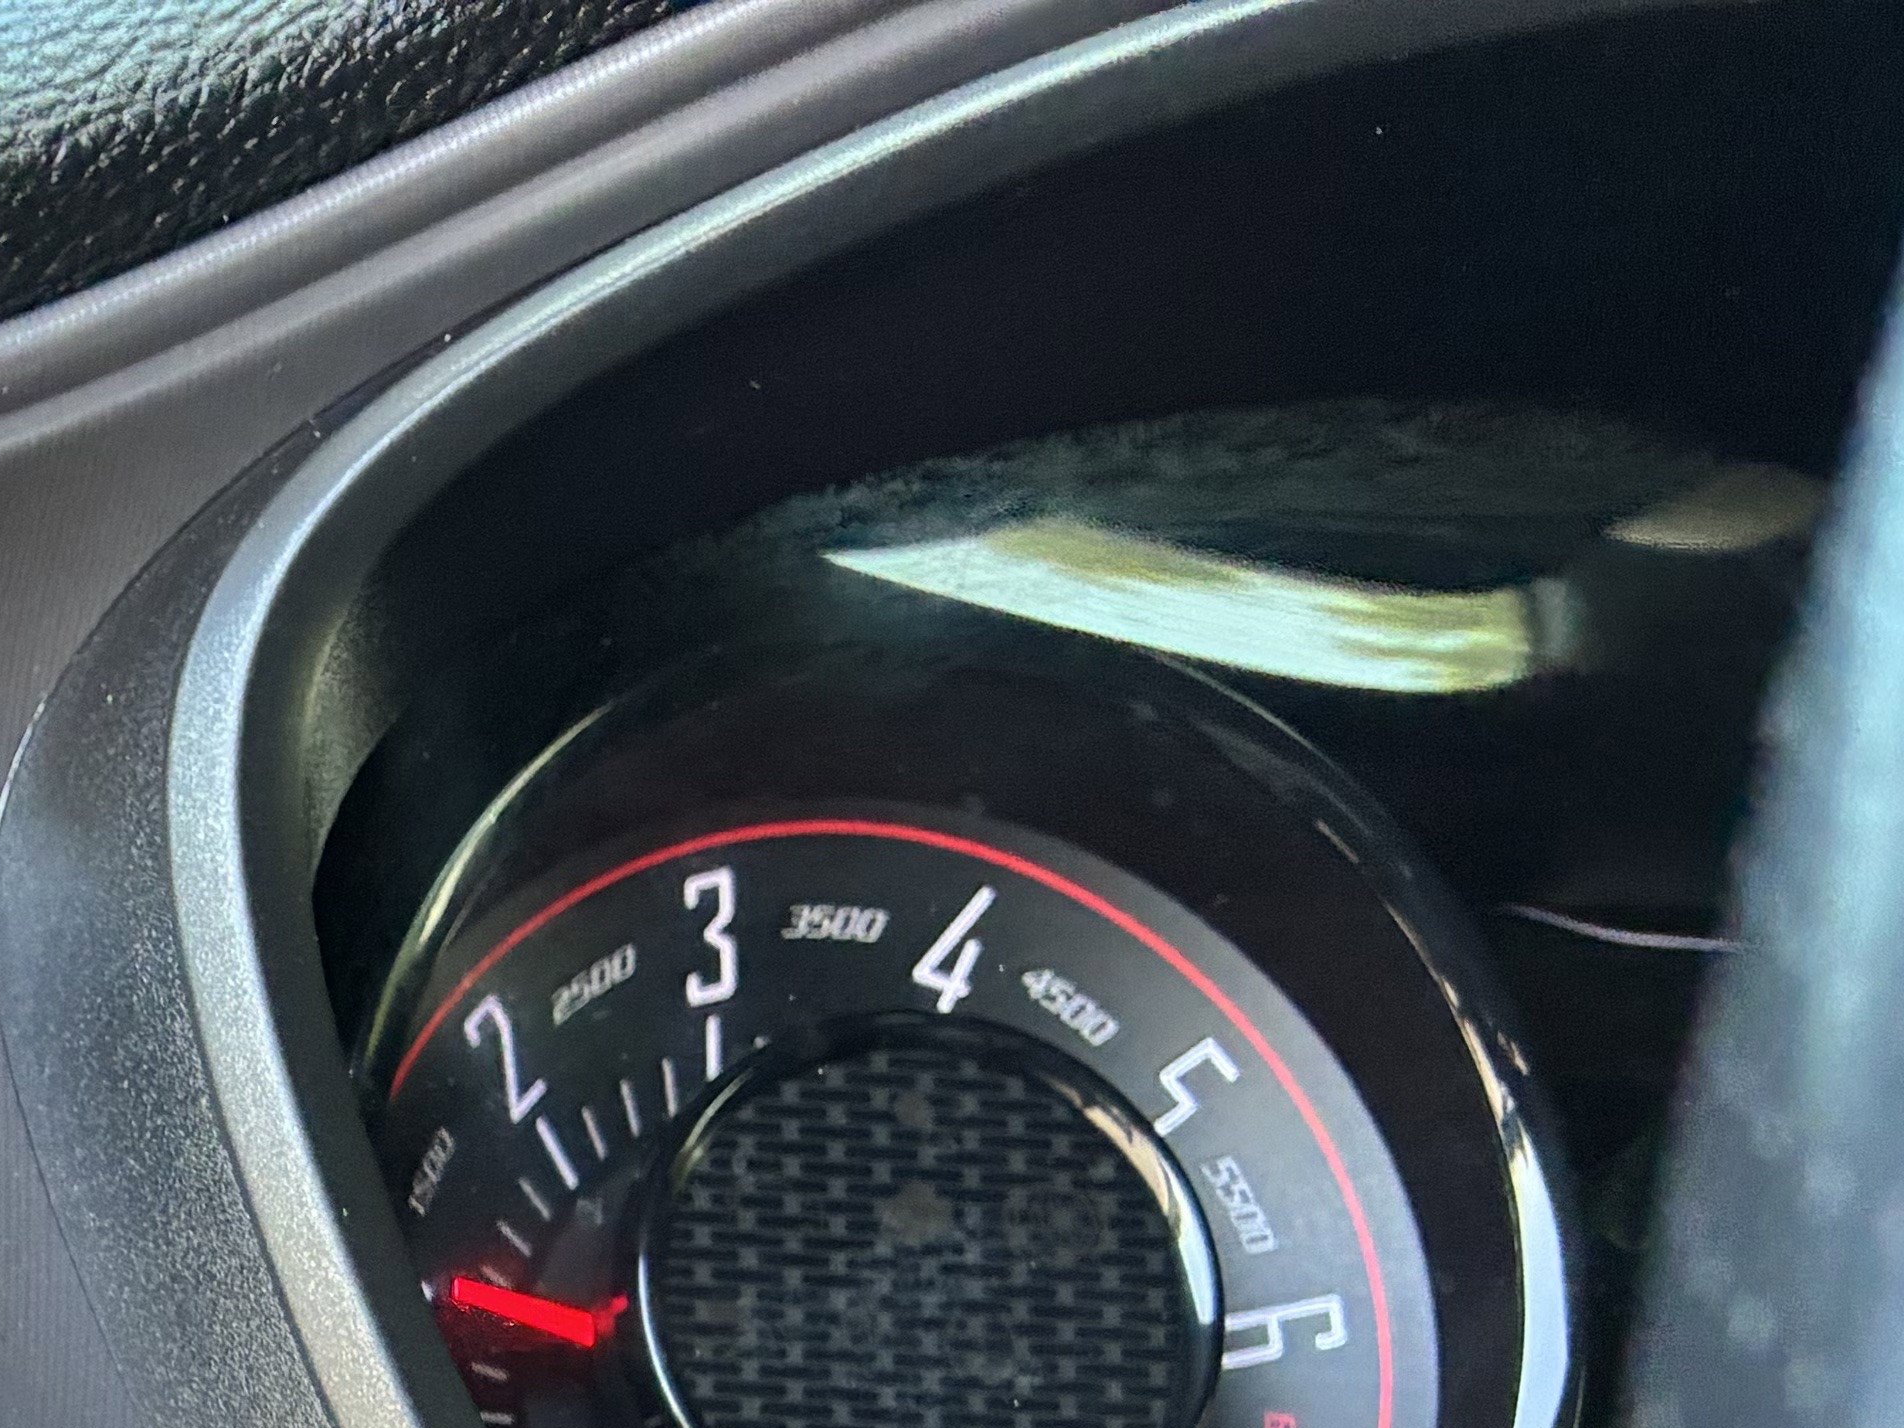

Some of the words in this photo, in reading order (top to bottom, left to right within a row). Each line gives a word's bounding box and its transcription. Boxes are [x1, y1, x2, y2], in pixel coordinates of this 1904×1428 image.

[683, 865, 739, 1008] 3
[780, 902, 891, 944] 3500
[911, 885, 995, 1014] 4
[552, 942, 638, 1027] 2500
[1020, 967, 1121, 1047] 4500
[464, 994, 548, 1126] 2
[1153, 1036, 1242, 1137] 5
[1199, 1154, 1277, 1255] 5500
[1220, 1293, 1349, 1371] 6
